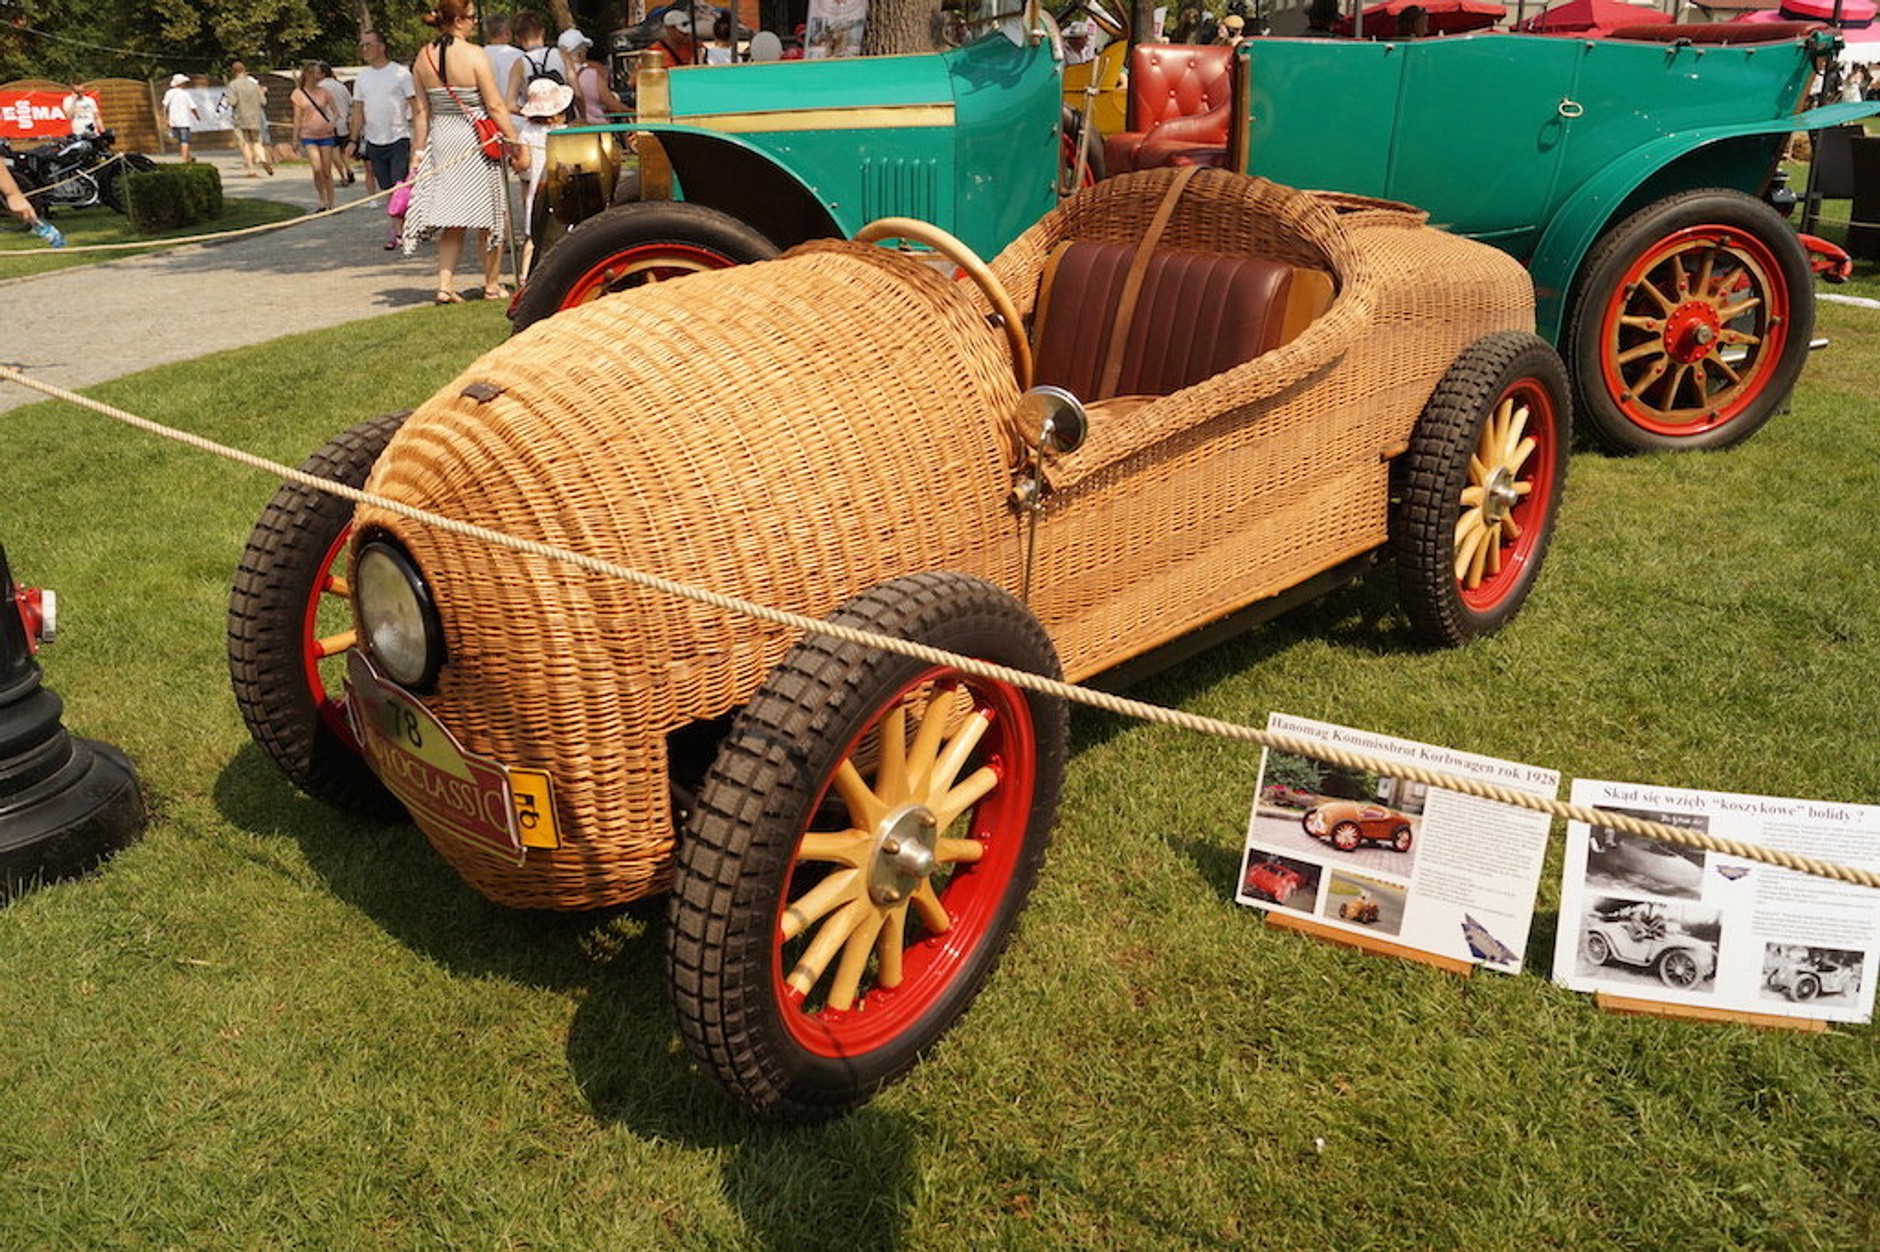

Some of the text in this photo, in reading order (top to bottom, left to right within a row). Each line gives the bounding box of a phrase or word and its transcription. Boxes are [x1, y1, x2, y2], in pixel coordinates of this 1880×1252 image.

[386, 699, 423, 749] 78
[1271, 716, 1557, 786] Hanomag Kommissbrot Korbwagen rok 1928
[1808, 806, 1850, 823] bolidy
